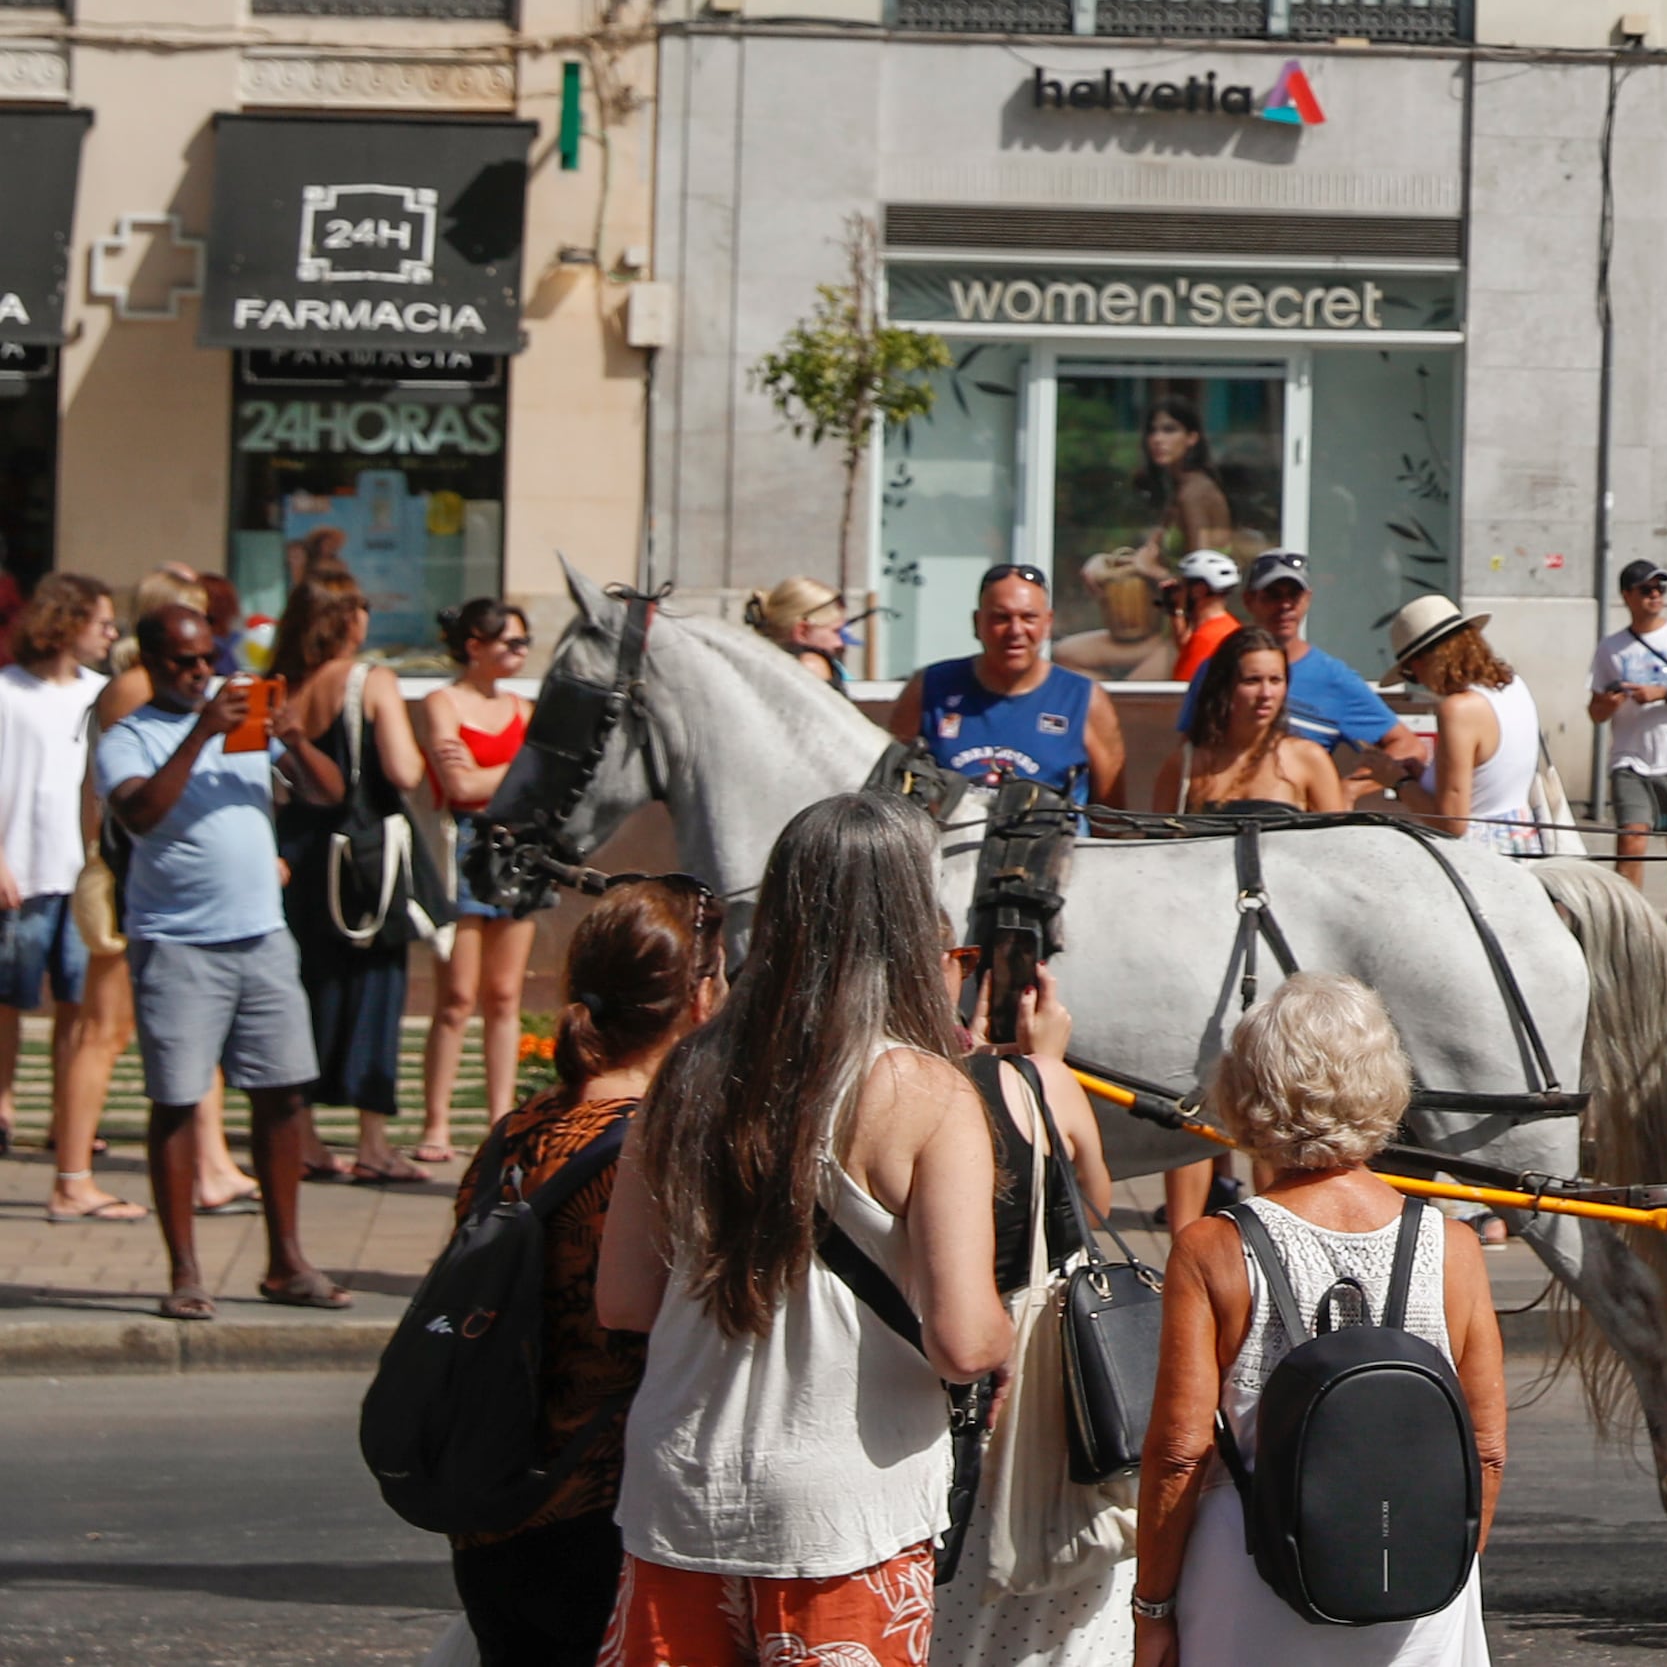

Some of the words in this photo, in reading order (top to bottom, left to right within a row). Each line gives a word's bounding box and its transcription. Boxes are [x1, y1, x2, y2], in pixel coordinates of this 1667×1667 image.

[1034, 66, 1253, 114] helvetia
[324, 218, 412, 250] 24H
[233, 298, 486, 333] FARMACIA
[949, 277, 1382, 328] women'secret
